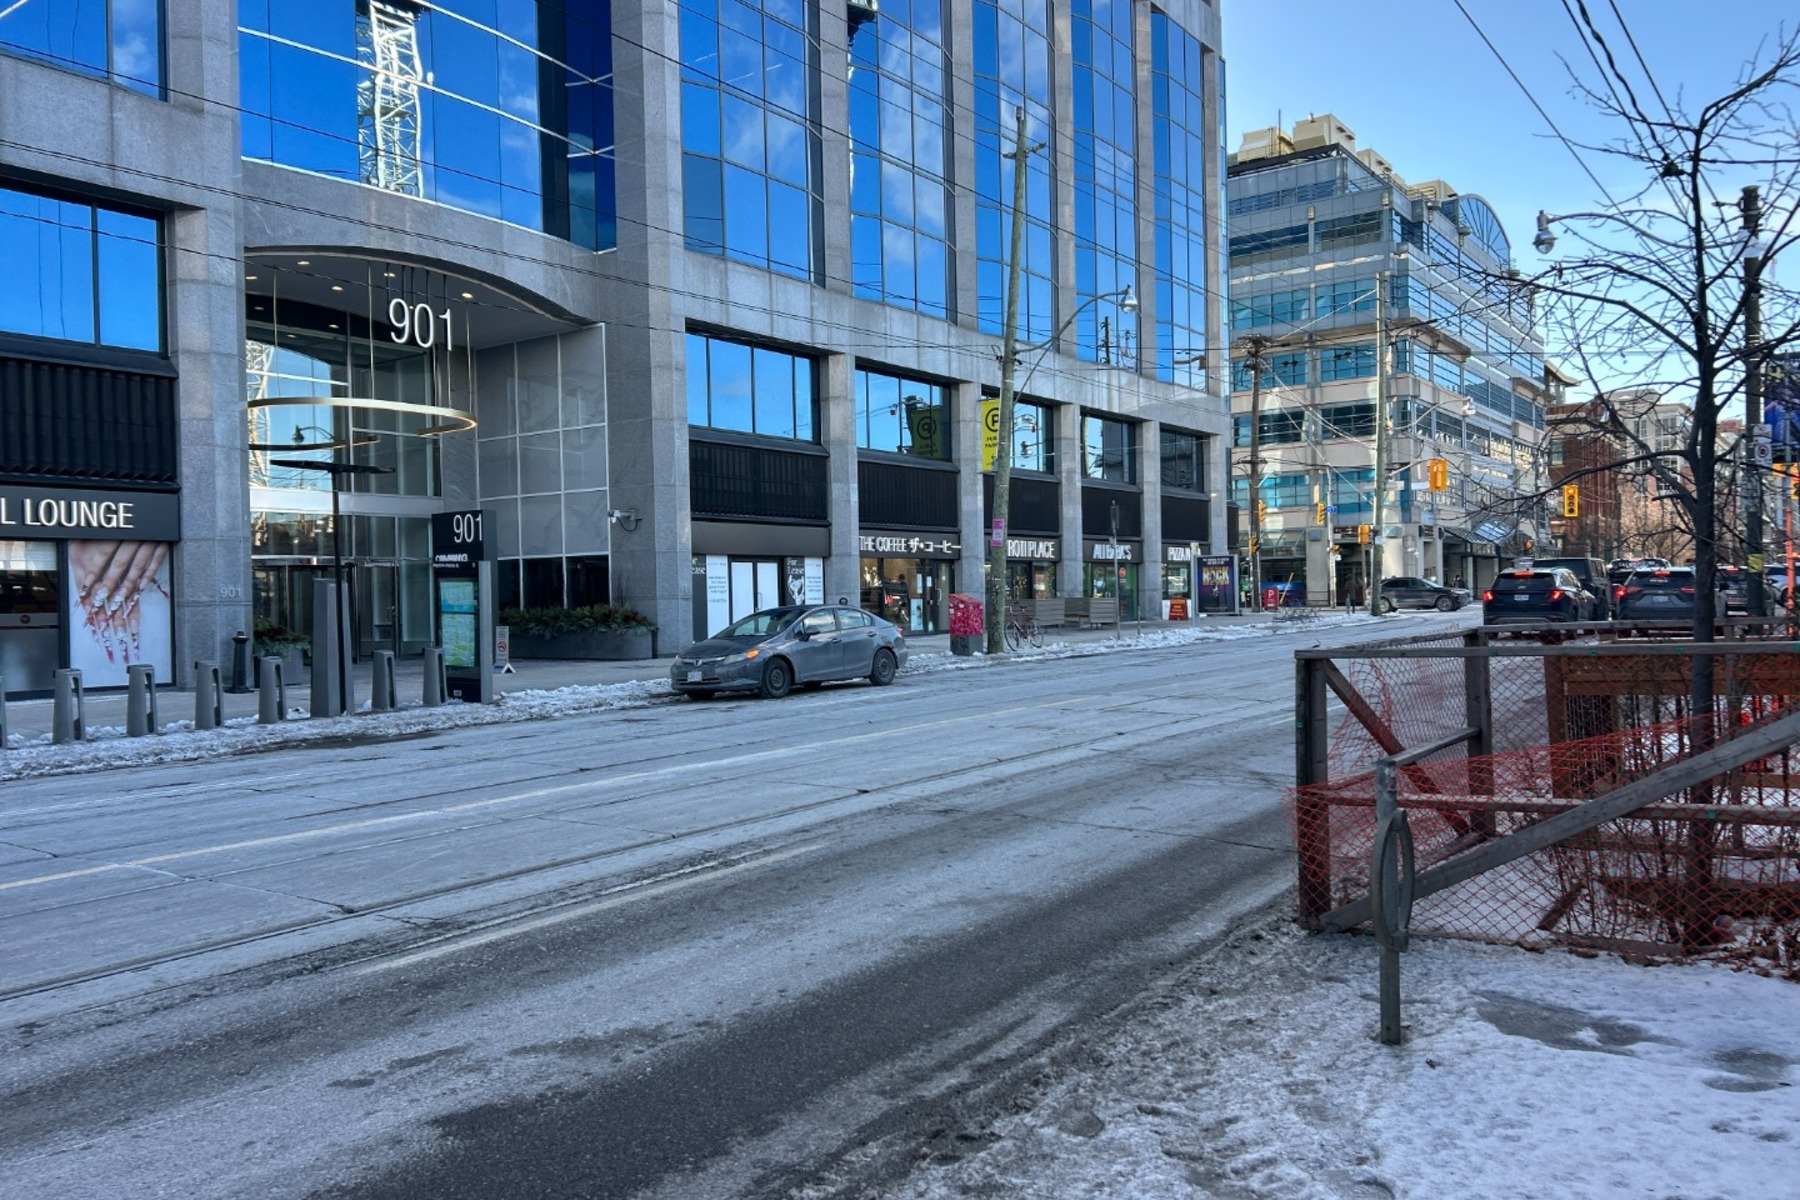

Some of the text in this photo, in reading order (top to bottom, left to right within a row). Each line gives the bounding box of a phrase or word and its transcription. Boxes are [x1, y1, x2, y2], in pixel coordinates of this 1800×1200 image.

[389, 298, 452, 351] 901
[23, 498, 135, 529] LOUNGE
[453, 513, 484, 543] 901
[859, 535, 876, 552] THE
[875, 536, 908, 552] COFFEE
[1028, 540, 1056, 559] PLACE
[691, 567, 706, 575] ease
[220, 586, 241, 598] 901
